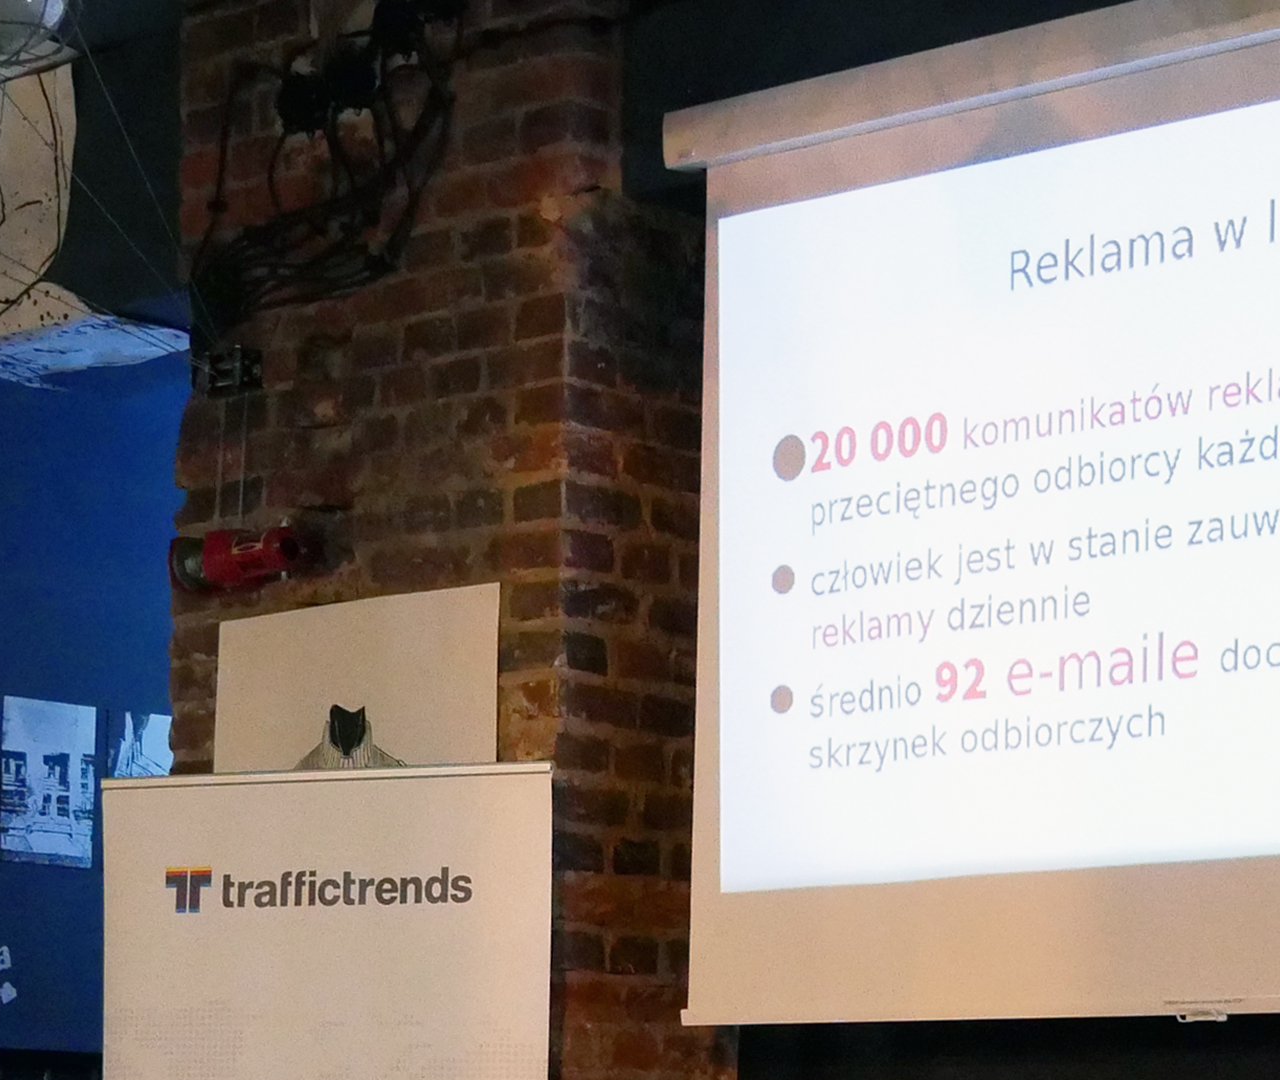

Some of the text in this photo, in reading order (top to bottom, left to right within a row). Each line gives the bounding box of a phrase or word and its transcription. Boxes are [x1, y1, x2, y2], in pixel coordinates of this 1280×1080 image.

[1009, 225, 1194, 292] Reklama
[1213, 215, 1248, 253] w
[809, 423, 858, 476] 20
[869, 411, 948, 465] 000
[963, 382, 1193, 450] komunikatów
[811, 473, 1020, 536] przeciętnego
[1033, 447, 1182, 494] odbiorcy
[810, 548, 943, 597] człowiek
[954, 538, 1016, 586] jest
[1029, 539, 1055, 566] w
[1068, 522, 1173, 562] stanie
[811, 588, 1091, 650] reklamy dziennie
[810, 677, 922, 719] średnio
[935, 657, 987, 703] 92
[1007, 629, 1199, 697] e-maile
[809, 703, 1166, 773] skrzynek odbiorczych
[222, 866, 473, 908] traffictrends
